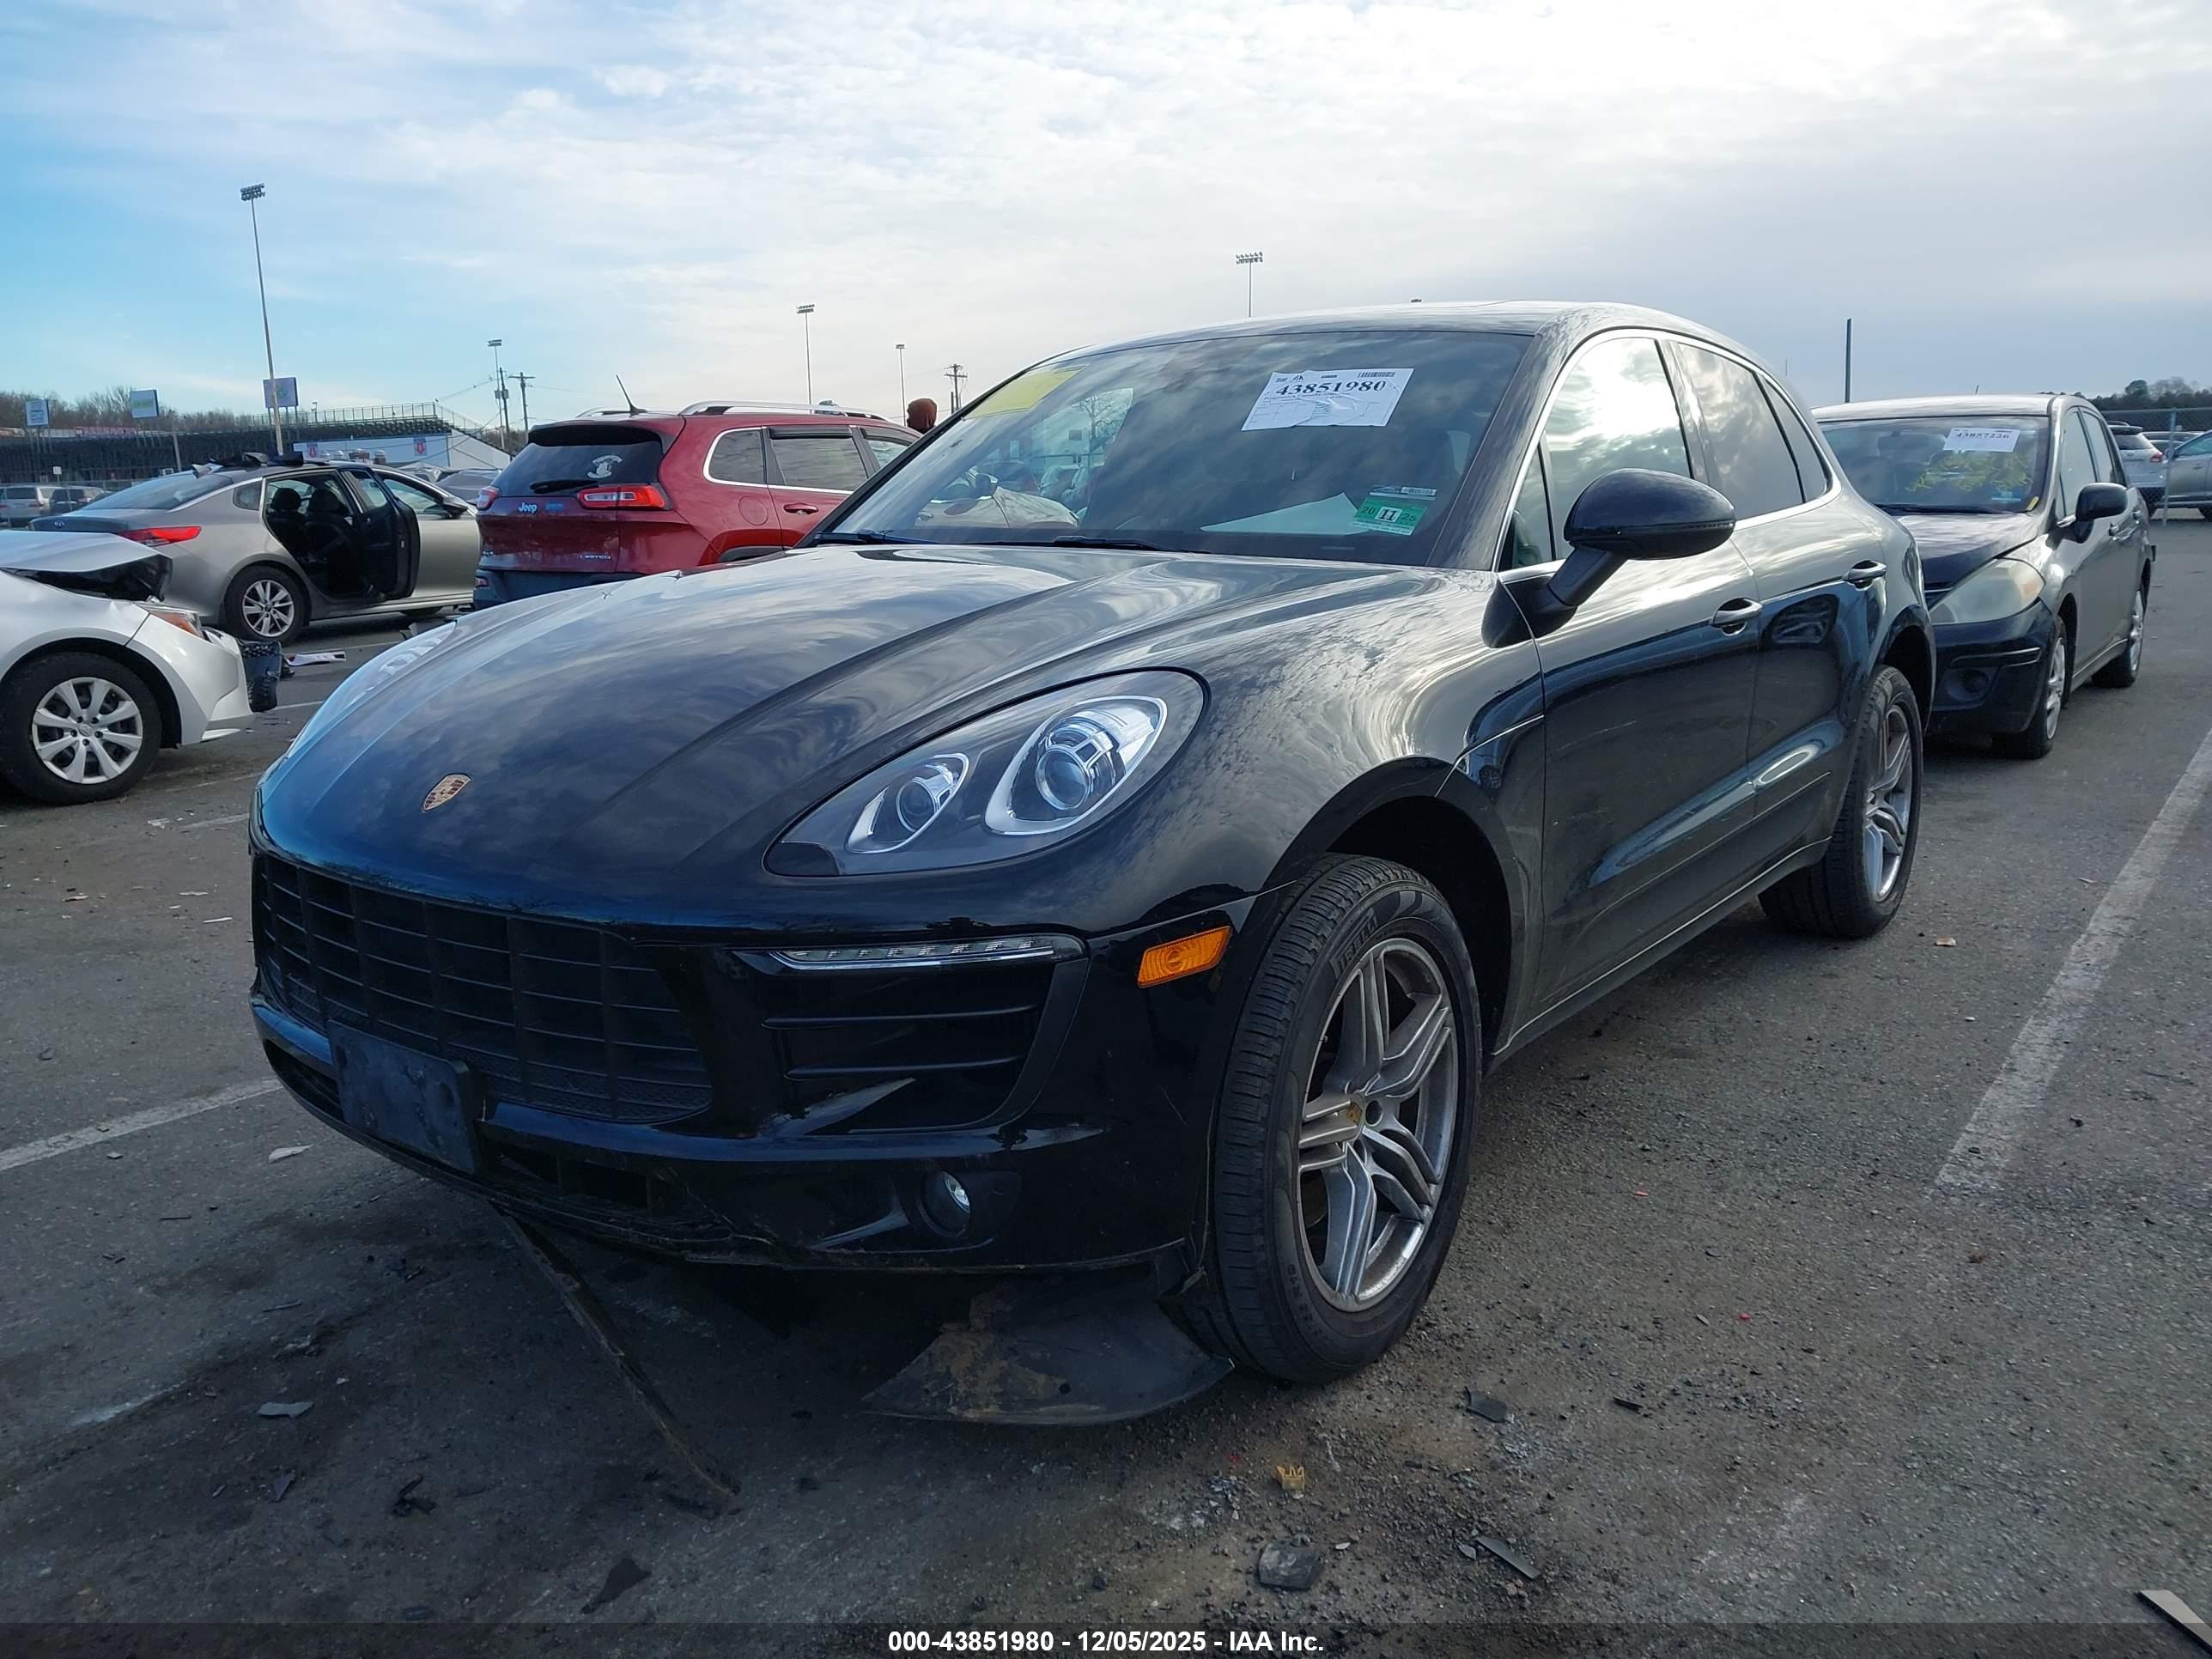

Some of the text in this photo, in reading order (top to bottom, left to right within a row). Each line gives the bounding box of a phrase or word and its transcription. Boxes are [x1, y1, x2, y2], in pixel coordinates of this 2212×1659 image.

[1276, 380, 1387, 396] 43851980
[519, 502, 537, 514] Jeep
[1361, 507, 1416, 522] 20 11 25
